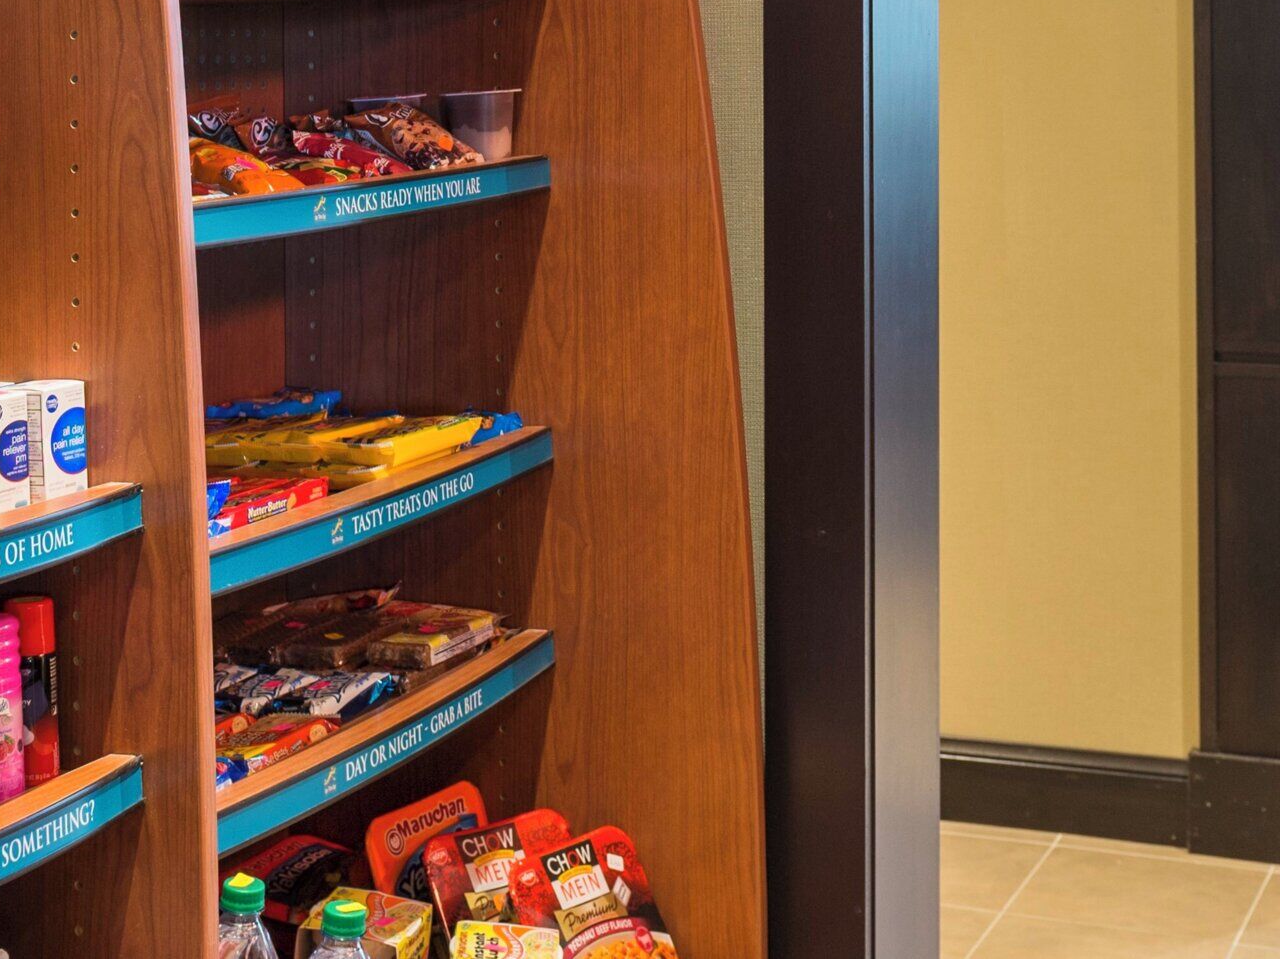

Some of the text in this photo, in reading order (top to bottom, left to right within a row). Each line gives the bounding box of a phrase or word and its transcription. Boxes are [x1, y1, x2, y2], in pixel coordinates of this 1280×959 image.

[335, 176, 481, 217] SNACKS READY WHEN YOU ARE
[11, 433, 27, 446] pain
[53, 436, 85, 453] pain relief
[62, 424, 85, 437] all day
[2, 443, 27, 457] reliever
[15, 456, 27, 466] pm
[248, 496, 288, 520] Nutter Butter
[352, 472, 474, 535] TASTY TREATS ON THE GO
[4, 538, 26, 566] OF
[30, 524, 74, 559] HOME
[345, 753, 369, 782] DAY
[370, 745, 387, 768] OR
[388, 723, 423, 758] NIGHT
[430, 705, 455, 734] GRAB
[455, 703, 463, 721] A
[464, 688, 483, 715] BITE
[1, 799, 95, 867] SOMETHING?
[396, 798, 466, 837] Maruchan
[461, 827, 515, 858] CHOW
[545, 843, 591, 876] CHOW
[560, 876, 601, 902] MEIN
[563, 898, 619, 931] Premium
[568, 917, 633, 954] TERIYAKI BEEF FLAVOR
